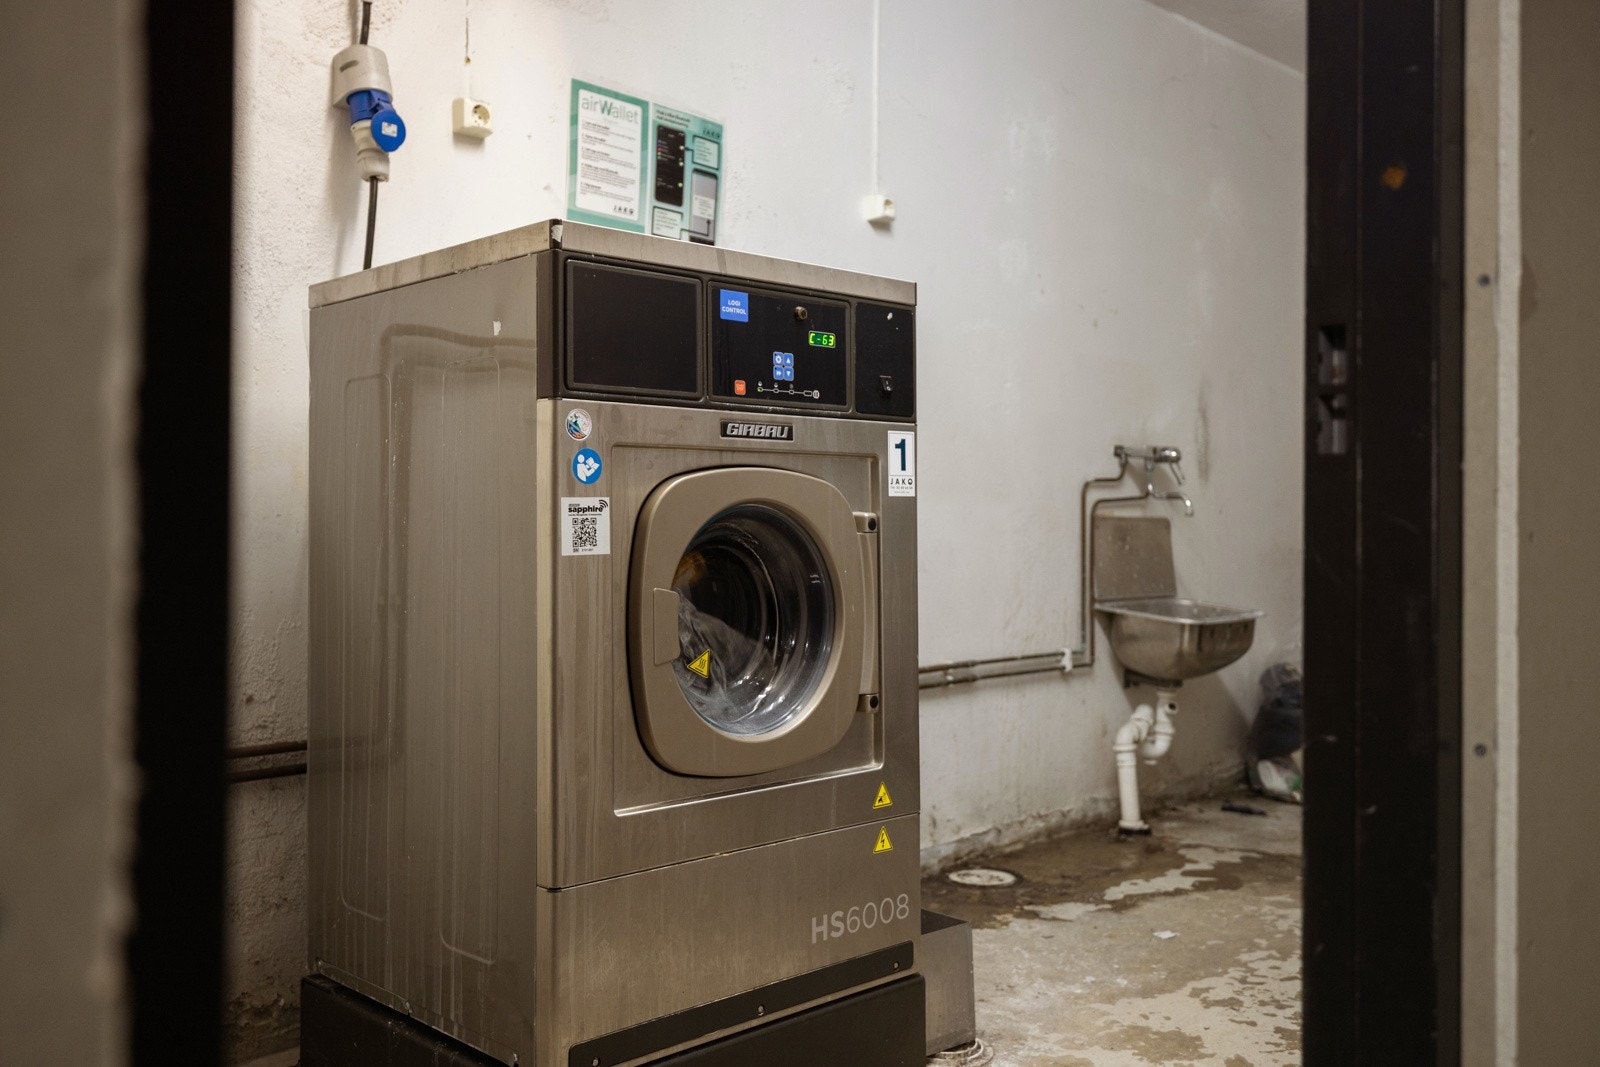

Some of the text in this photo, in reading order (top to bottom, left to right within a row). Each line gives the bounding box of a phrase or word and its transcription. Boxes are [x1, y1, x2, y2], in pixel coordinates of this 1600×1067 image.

[581, 96, 639, 124] airWallet
[728, 299, 741, 307] LOGI
[721, 306, 747, 315] CONTROL
[809, 333, 834, 346] C-63
[726, 423, 789, 438] GIRBAU
[894, 438, 906, 471] 1
[568, 505, 604, 514] sapphire
[811, 893, 910, 945] HS6008
